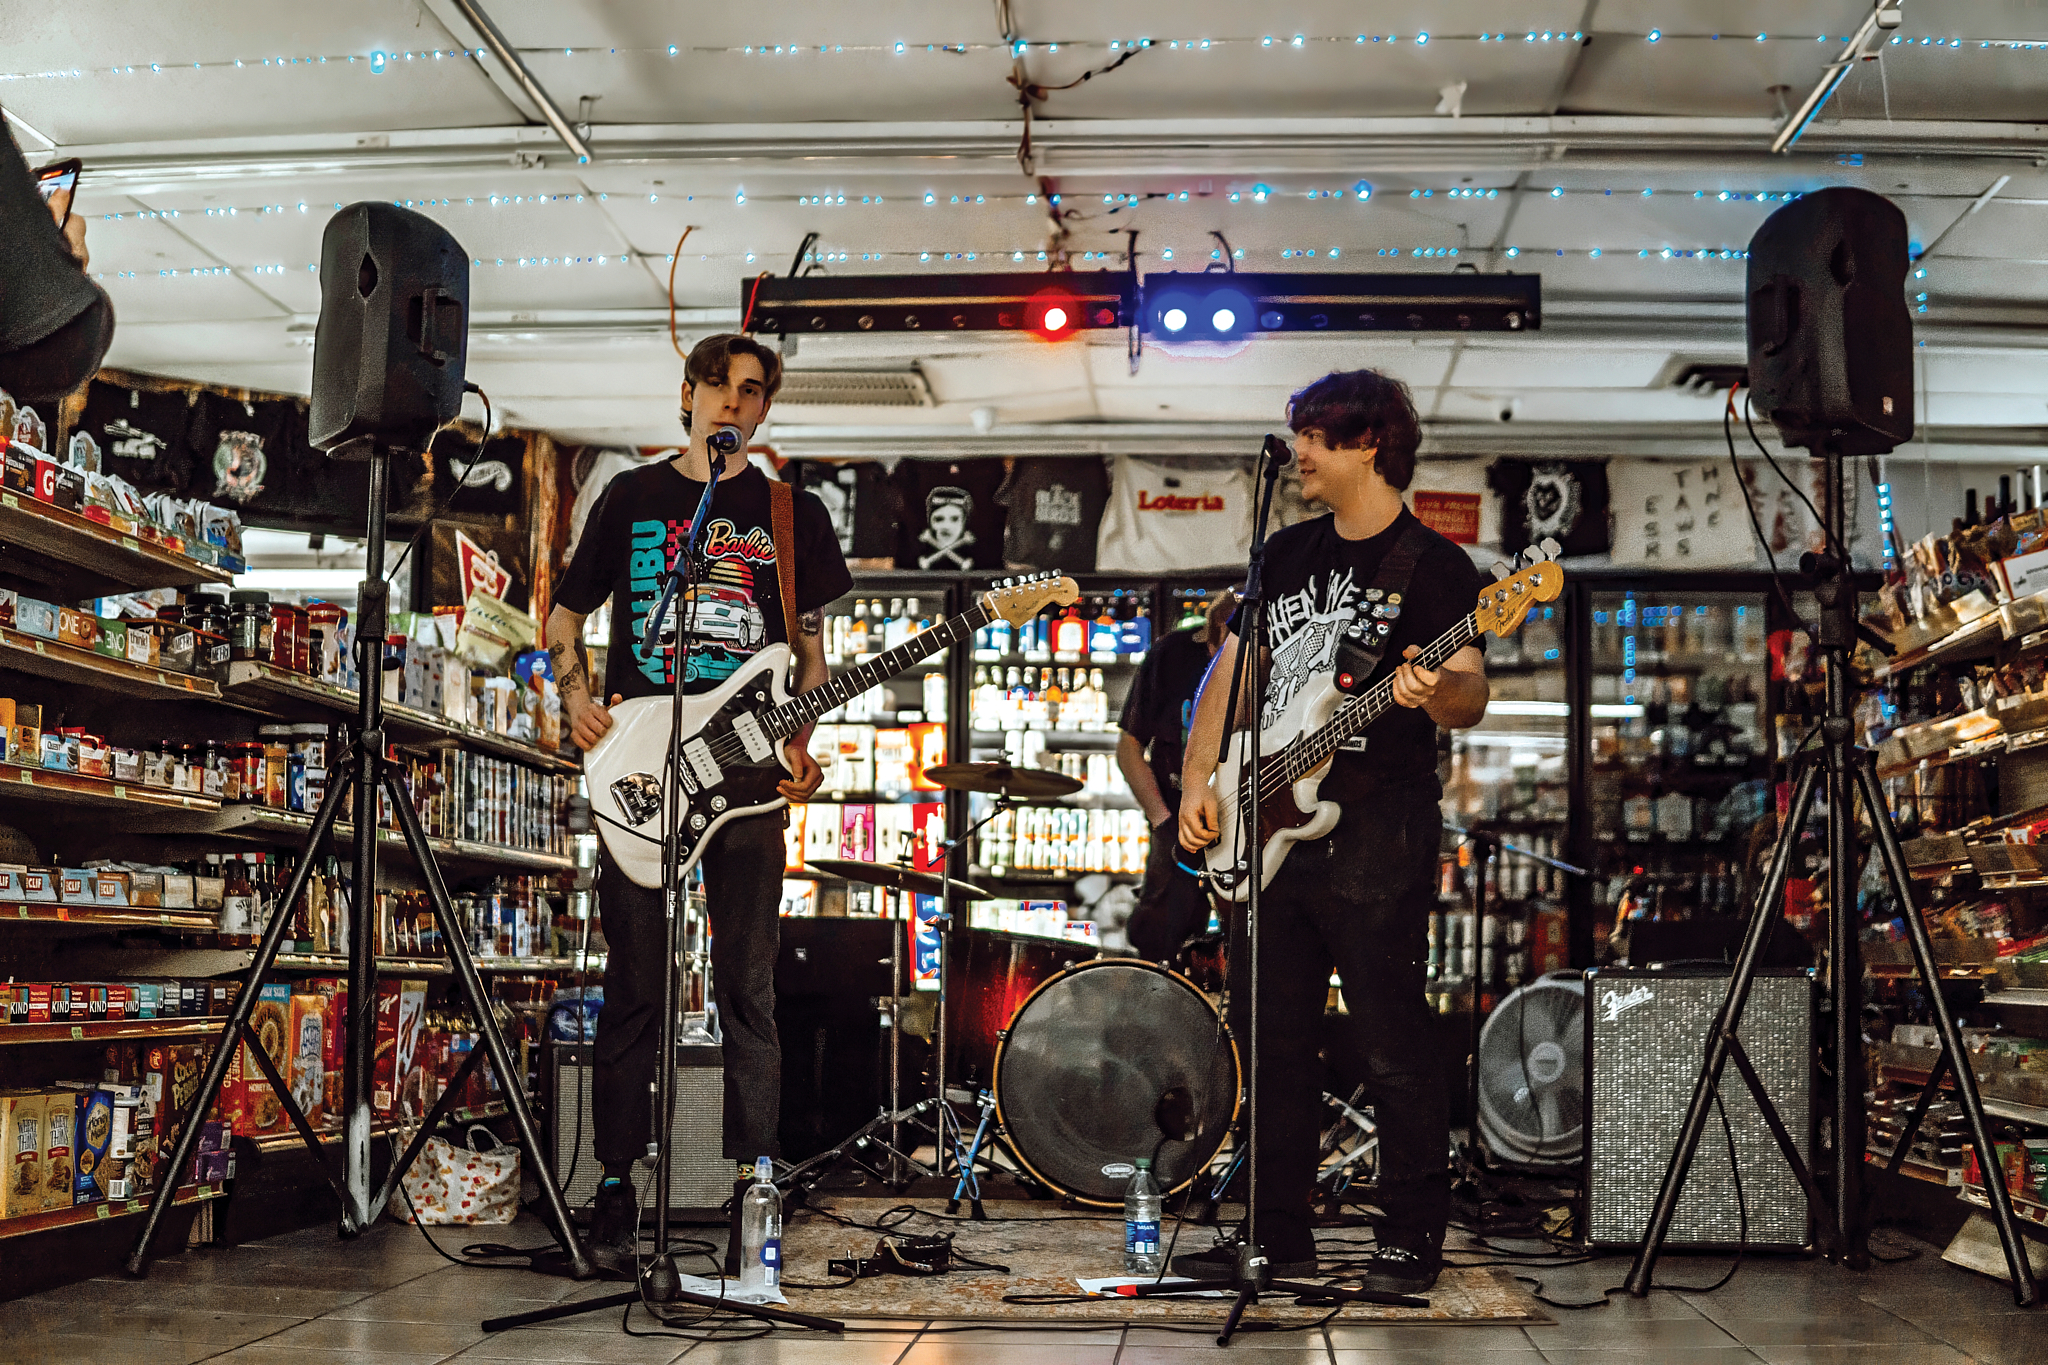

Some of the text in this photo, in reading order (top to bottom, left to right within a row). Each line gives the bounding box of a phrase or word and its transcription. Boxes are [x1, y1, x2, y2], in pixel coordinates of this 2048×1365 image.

[43, 469, 54, 496] G
[705, 519, 776, 563] Barbie
[20, 603, 42, 626] ONE
[60, 612, 79, 635] ONE
[28, 877, 41, 889] CLIF
[68, 881, 80, 893] CLIF
[103, 885, 114, 896] CLIF
[10, 1002, 28, 1014] KIND
[51, 1001, 70, 1013] KIND
[89, 1001, 107, 1013] KIND
[125, 1001, 139, 1012] KIND
